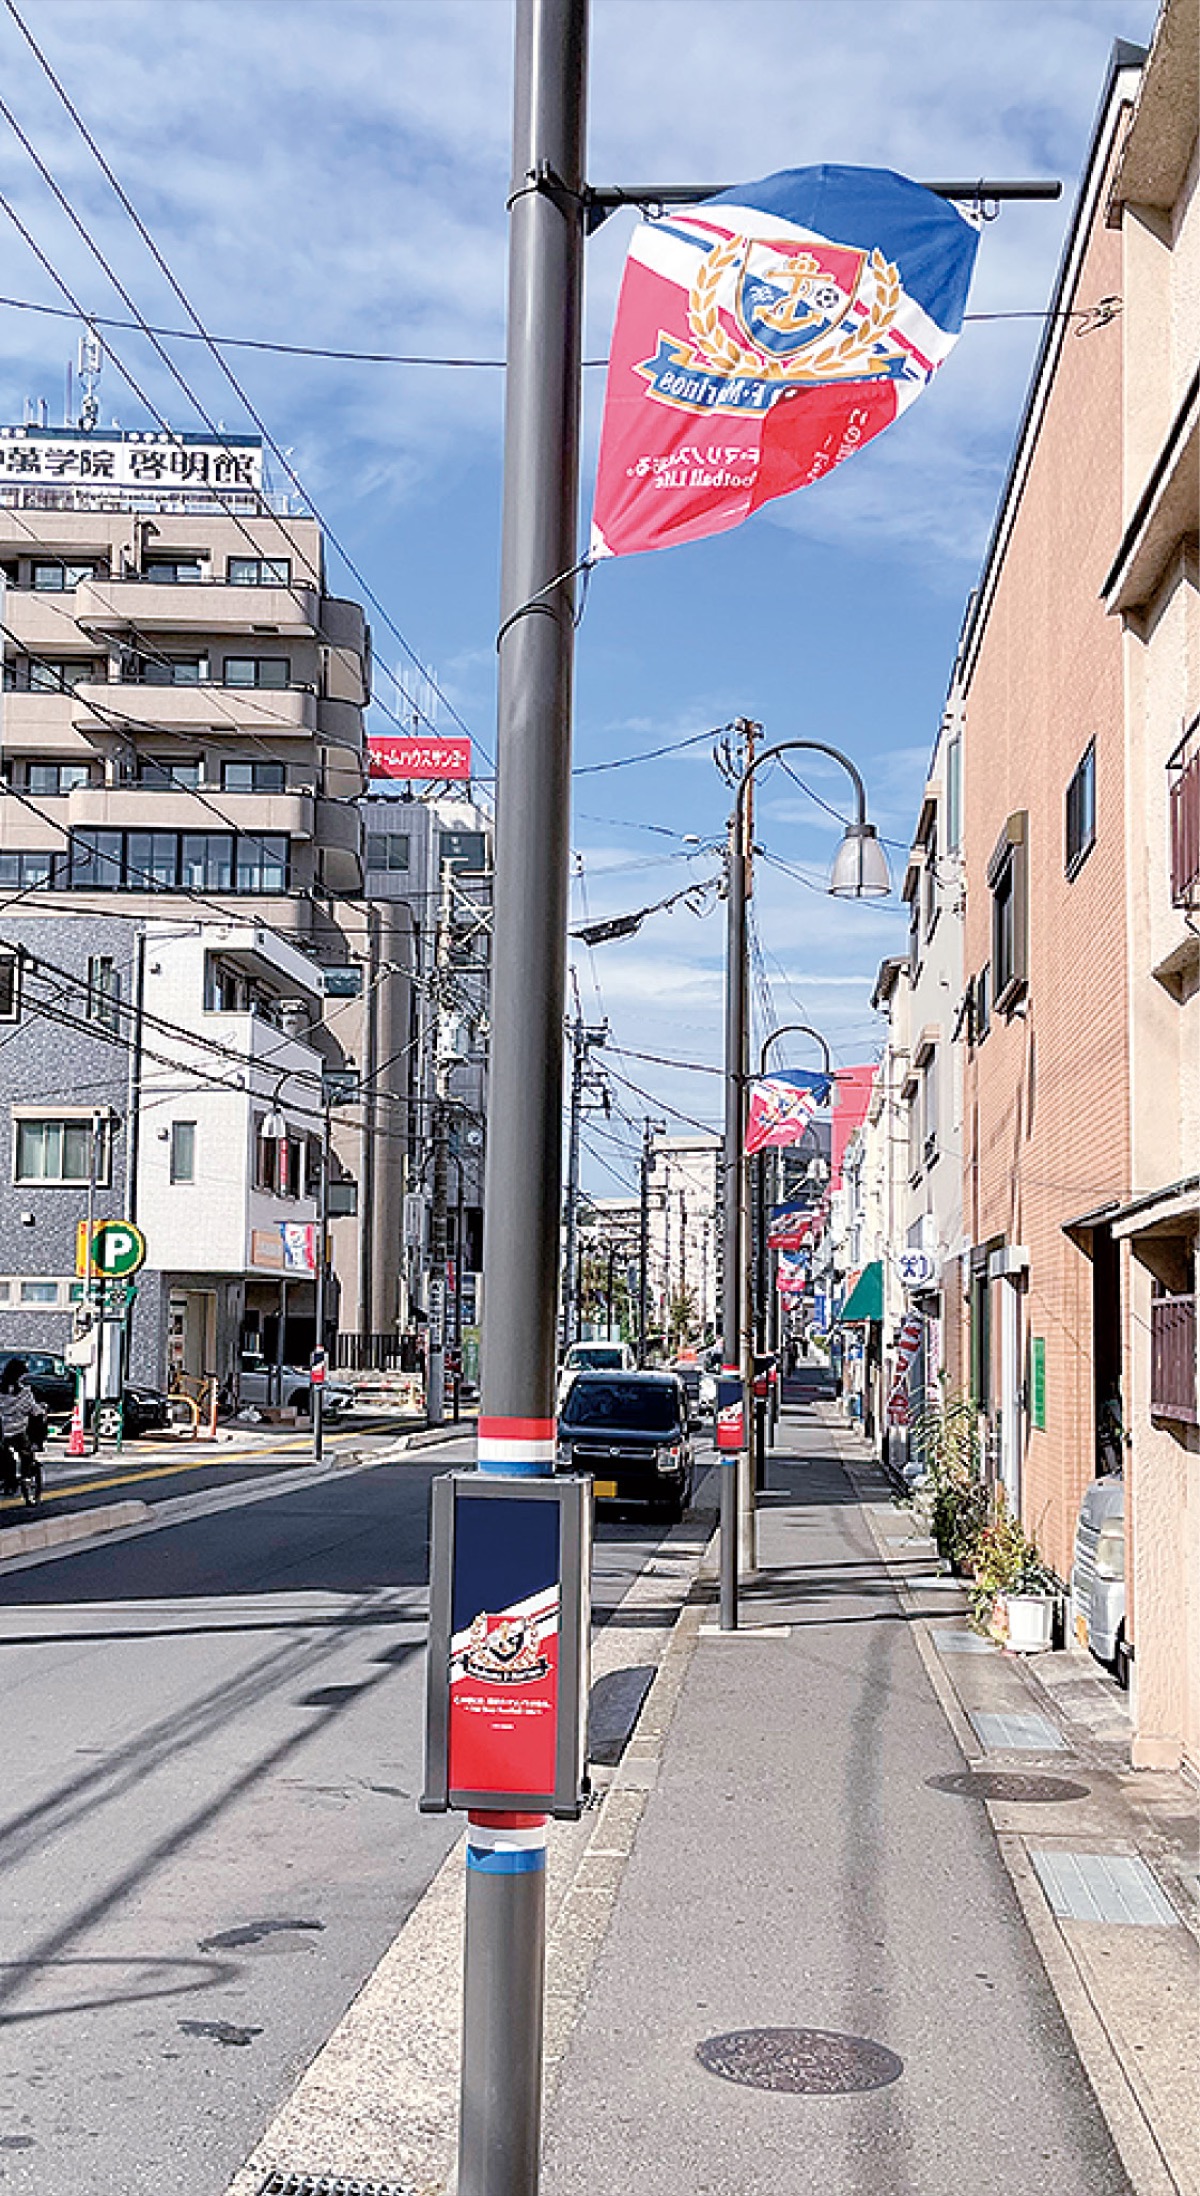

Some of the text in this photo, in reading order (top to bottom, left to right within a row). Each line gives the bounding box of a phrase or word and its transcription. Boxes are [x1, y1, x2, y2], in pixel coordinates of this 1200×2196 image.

[0, 446, 255, 483] 萬学院 啓明館
[105, 1233, 132, 1268] P
